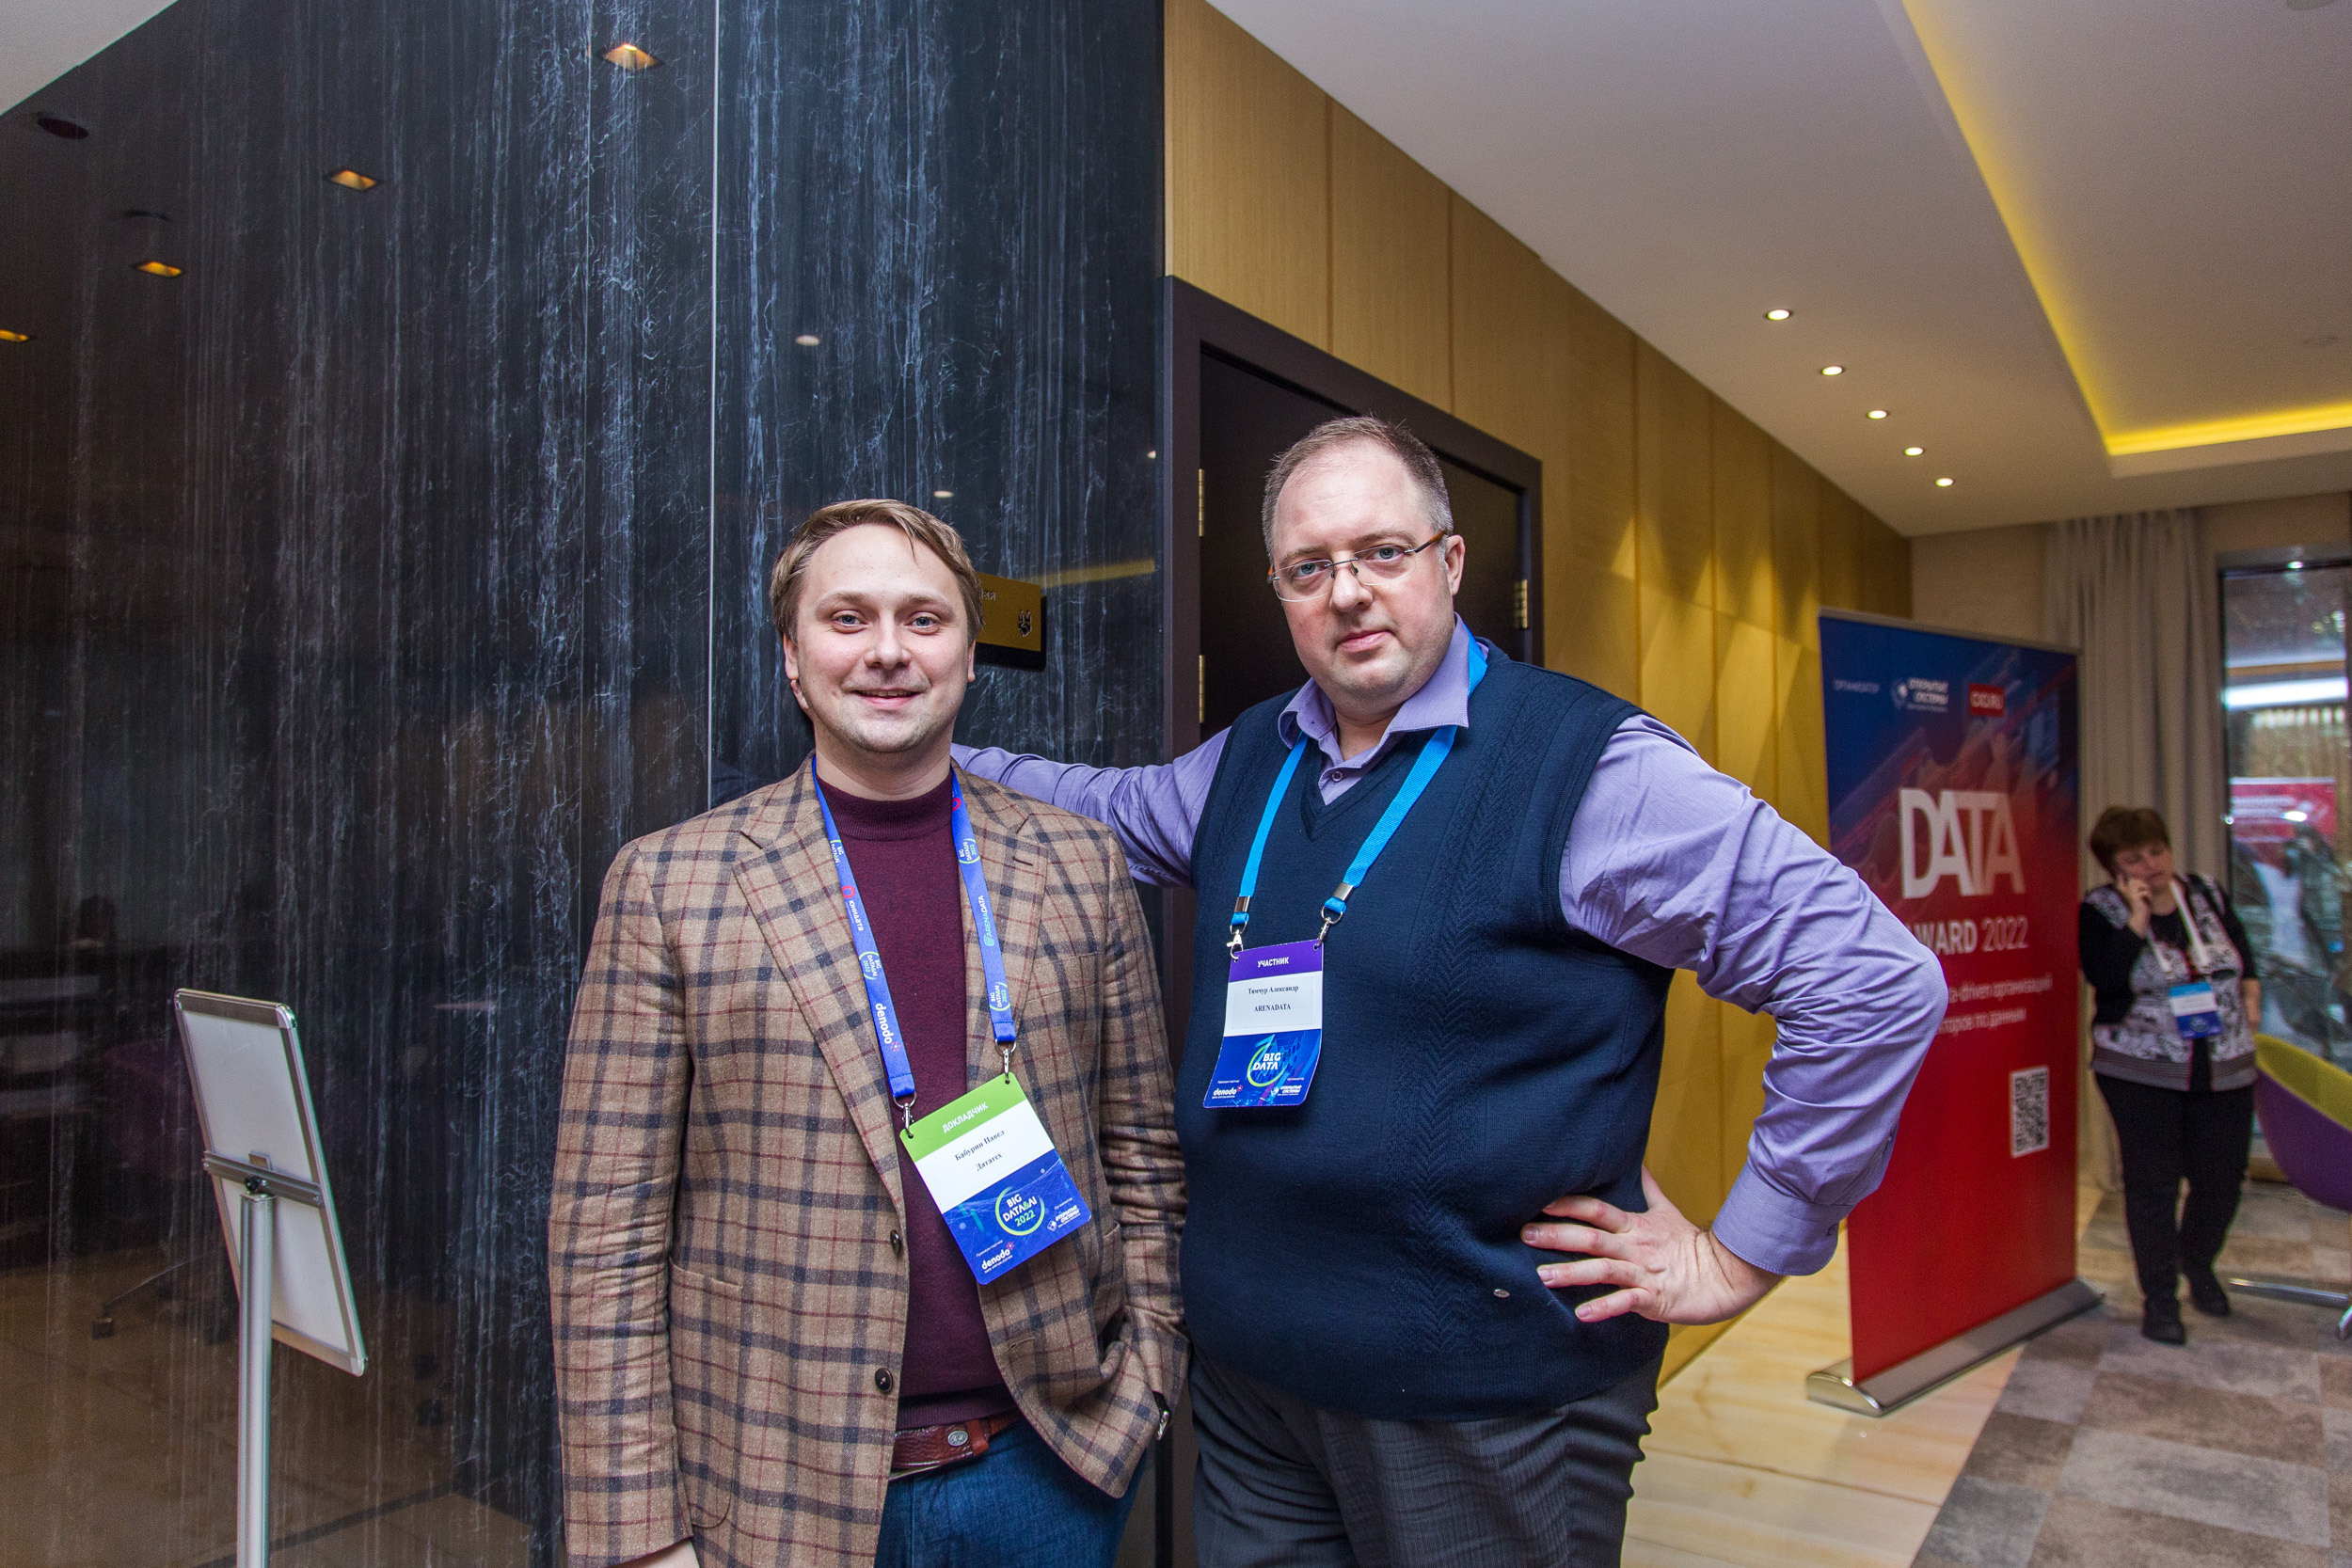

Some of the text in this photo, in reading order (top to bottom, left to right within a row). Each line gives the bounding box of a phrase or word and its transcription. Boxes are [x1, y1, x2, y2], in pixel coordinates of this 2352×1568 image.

[1899, 787, 2026, 899] DATA
[1905, 915, 2028, 955] WARD 2022
[1257, 957, 1289, 968] УЧАСТНИК
[1269, 985, 1298, 993] Александр
[1254, 1004, 1291, 1012] ARENADATA
[875, 1003, 893, 1044] denodo
[1252, 1062, 1279, 1070] DATA
[1263, 1053, 1281, 1062] BIG
[942, 1101, 989, 1133] ДОКЛАДЧИК
[955, 1130, 1006, 1162] Бабурин Павел
[977, 1152, 1003, 1172] Дататех
[1003, 1196, 1038, 1223] DATA&AI
[1006, 1194, 1023, 1209] BIG
[1014, 1211, 1036, 1227] 2022
[981, 1248, 1010, 1270] denodo
